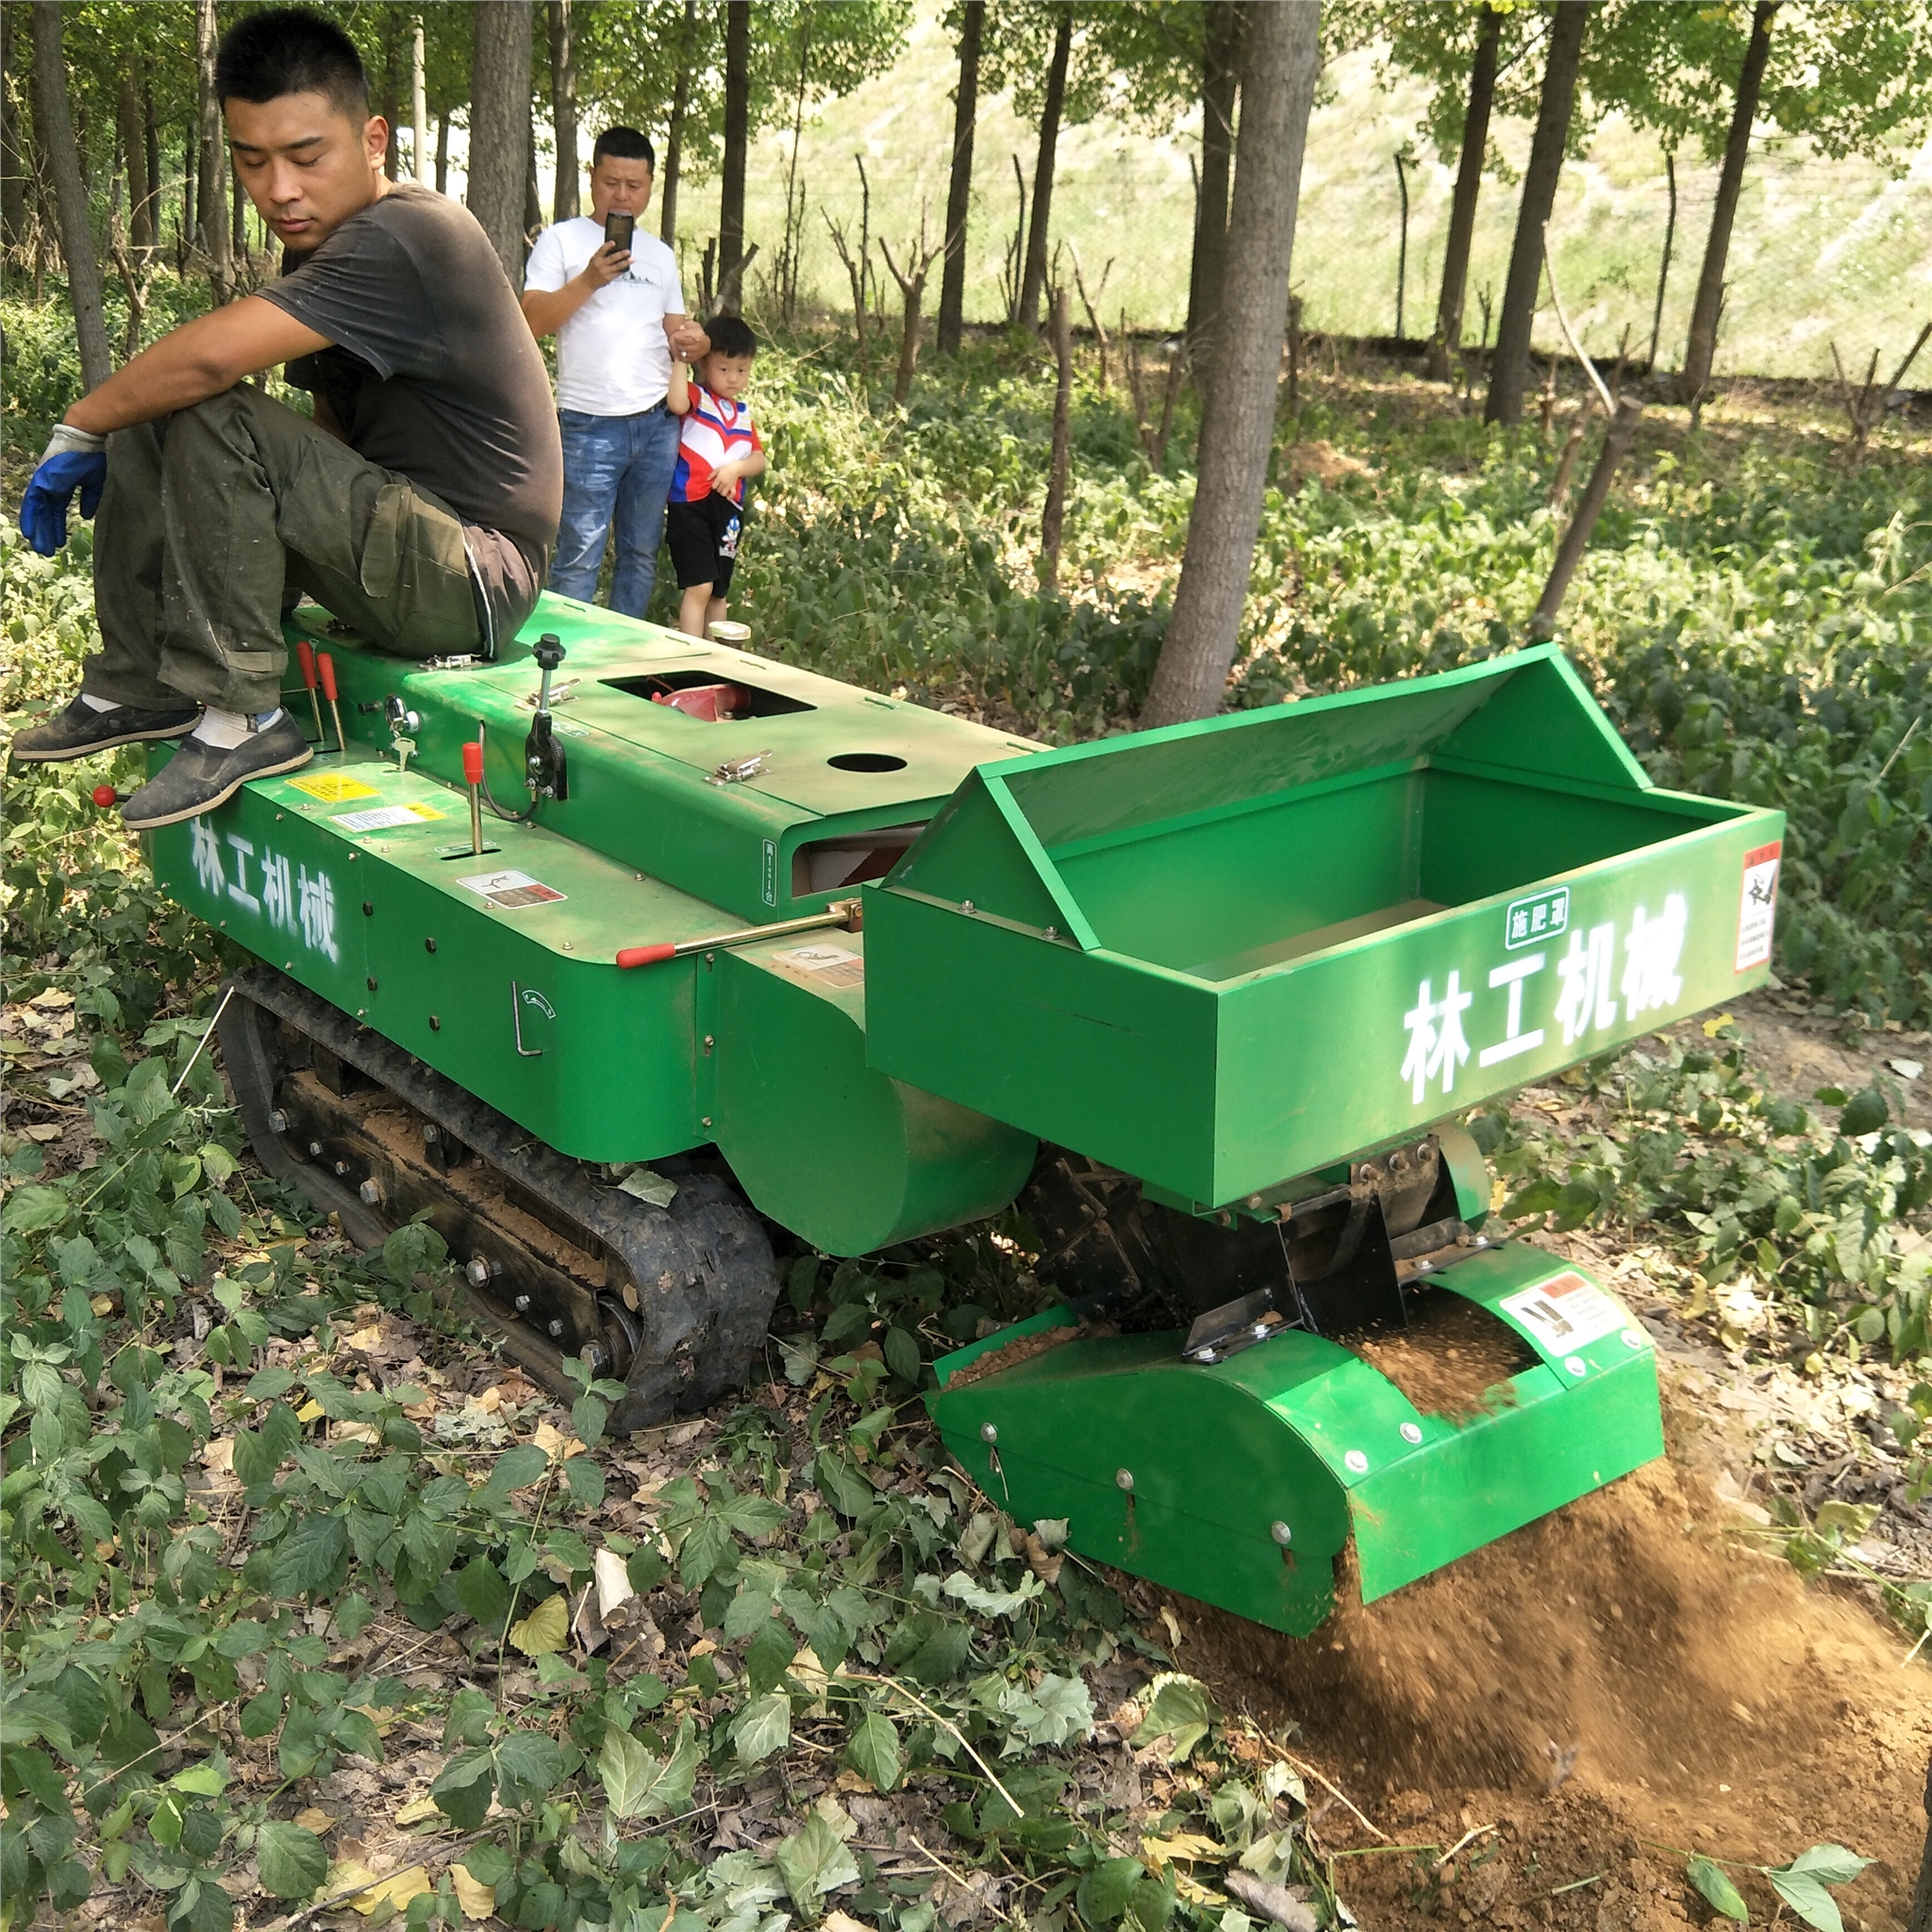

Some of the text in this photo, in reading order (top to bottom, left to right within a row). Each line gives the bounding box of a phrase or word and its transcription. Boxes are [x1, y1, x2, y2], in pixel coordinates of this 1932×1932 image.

[190, 814, 341, 964] 林工机械
[1511, 897, 1566, 940] 施肥罩
[1399, 892, 1688, 1106] 林工机械
